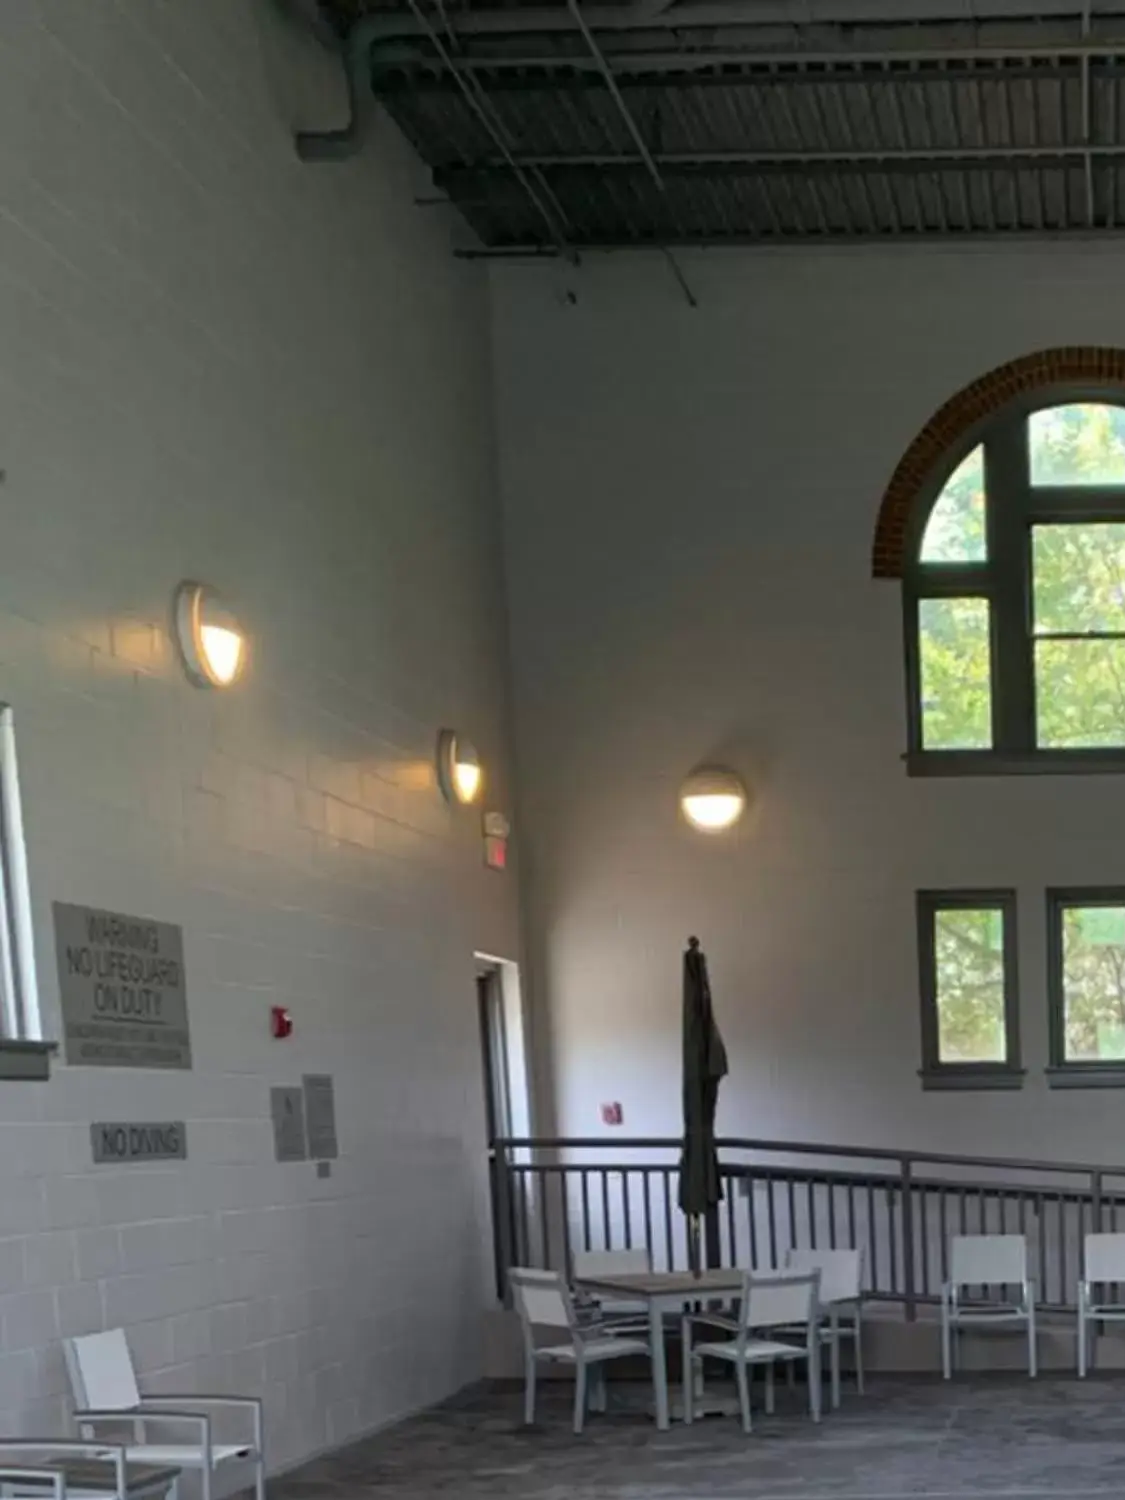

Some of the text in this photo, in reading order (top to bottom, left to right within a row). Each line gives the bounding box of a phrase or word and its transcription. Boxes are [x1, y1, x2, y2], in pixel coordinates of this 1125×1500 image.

[87, 914, 158, 953] WARNING
[66, 944, 179, 988] NO LIFEGUARD
[94, 982, 162, 1016] ON DUTY
[102, 1126, 179, 1156] NO DIVING
